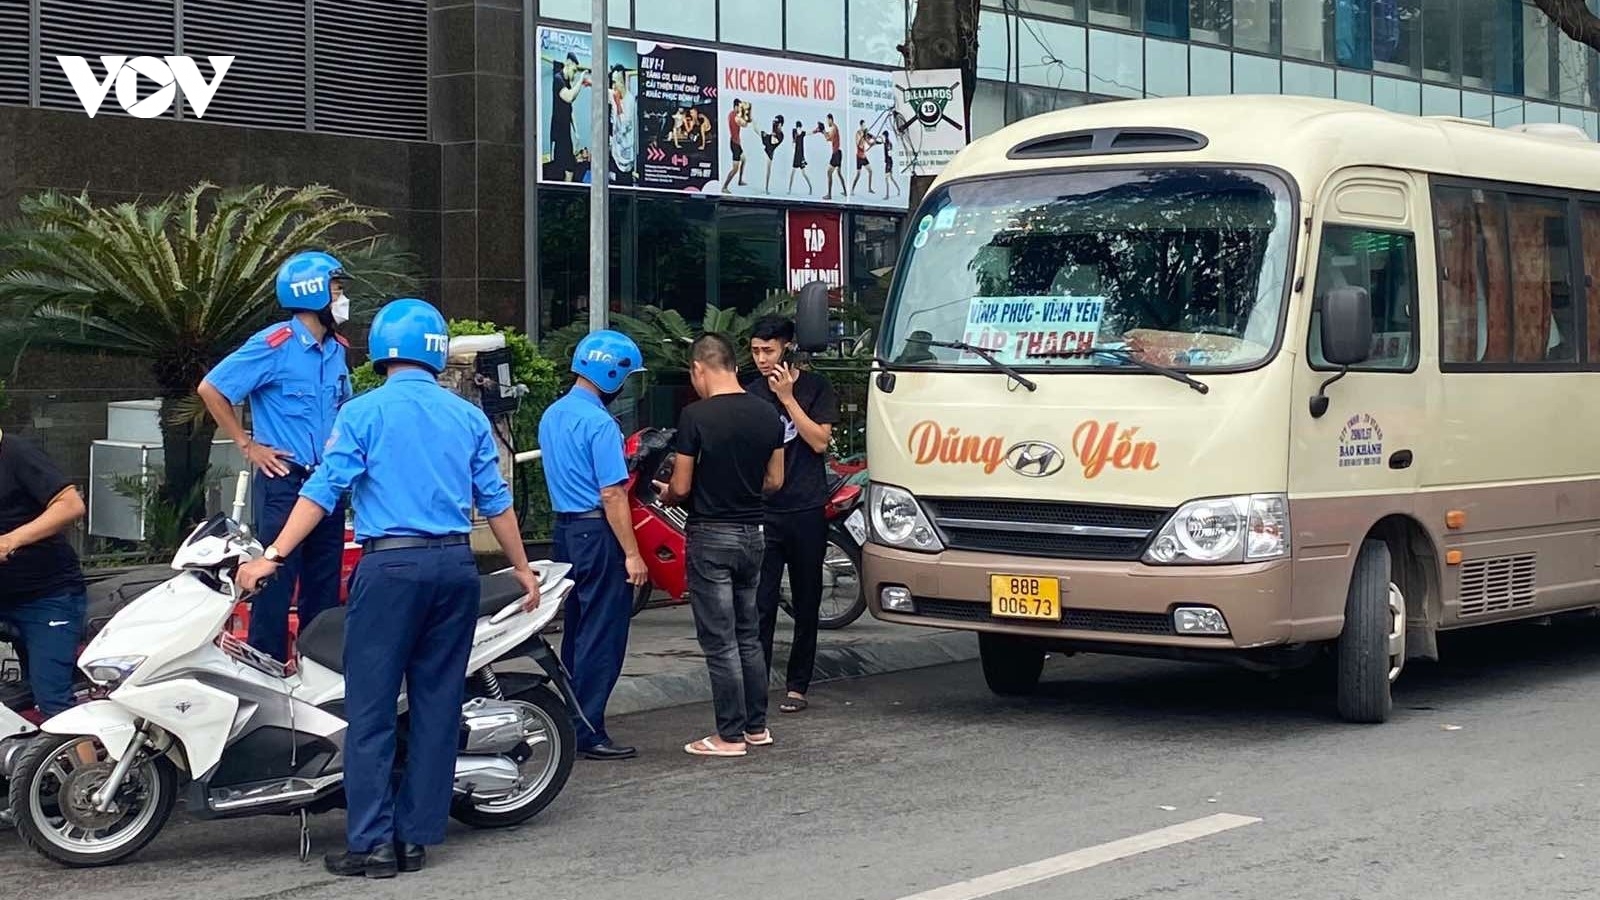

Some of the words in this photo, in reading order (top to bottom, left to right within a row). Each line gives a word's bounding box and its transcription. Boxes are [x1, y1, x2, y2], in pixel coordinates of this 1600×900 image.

[725, 67, 808, 98] KICKBOXING
[814, 77, 836, 101] KID
[904, 87, 953, 101] BILLIARDS
[924, 105, 935, 113] 19
[803, 222, 826, 258] TẬP
[289, 276, 325, 298] TTGT
[1000, 299, 1034, 322] PHÚC
[1042, 299, 1073, 322] VĨNH
[1013, 331, 1096, 363] THẠCH
[908, 420, 1006, 475] Dũng
[1072, 420, 1160, 479] Yến
[1011, 578, 1039, 595] 88B
[999, 597, 1052, 616] 006.73
